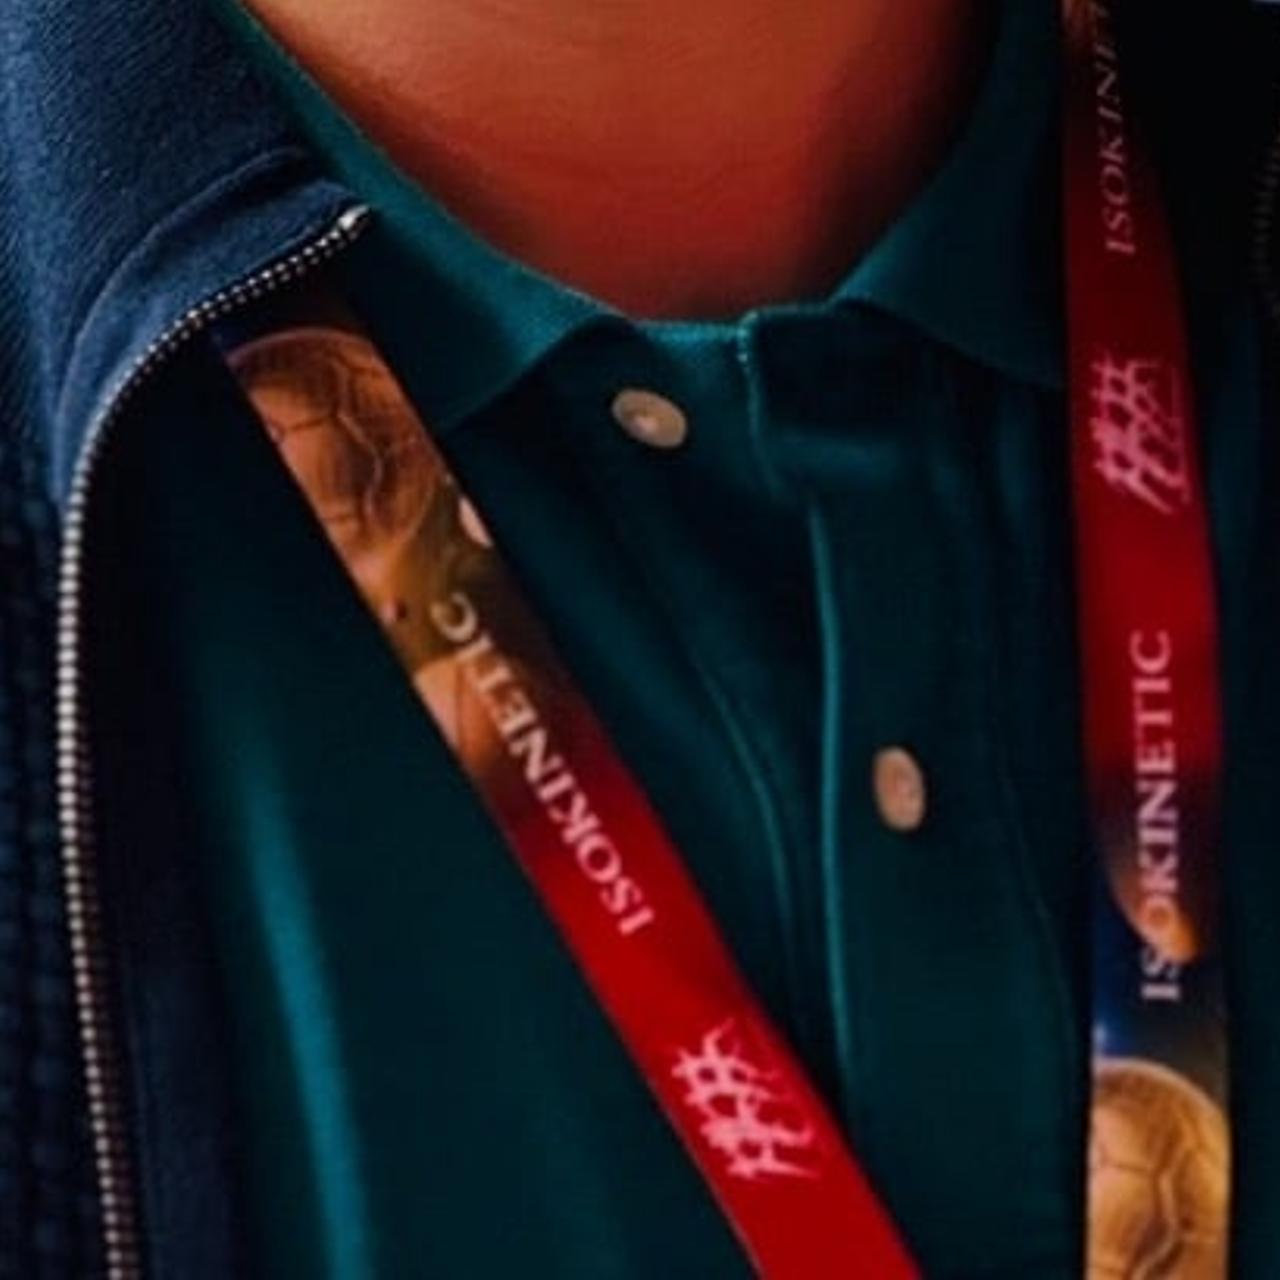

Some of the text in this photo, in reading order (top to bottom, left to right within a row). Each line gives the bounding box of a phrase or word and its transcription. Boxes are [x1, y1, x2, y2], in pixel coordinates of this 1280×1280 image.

[1094, 1, 1136, 254] ISOKIN
[431, 592, 654, 935] ISOKINETIC
[1131, 631, 1180, 1001] ISOKINETIC
